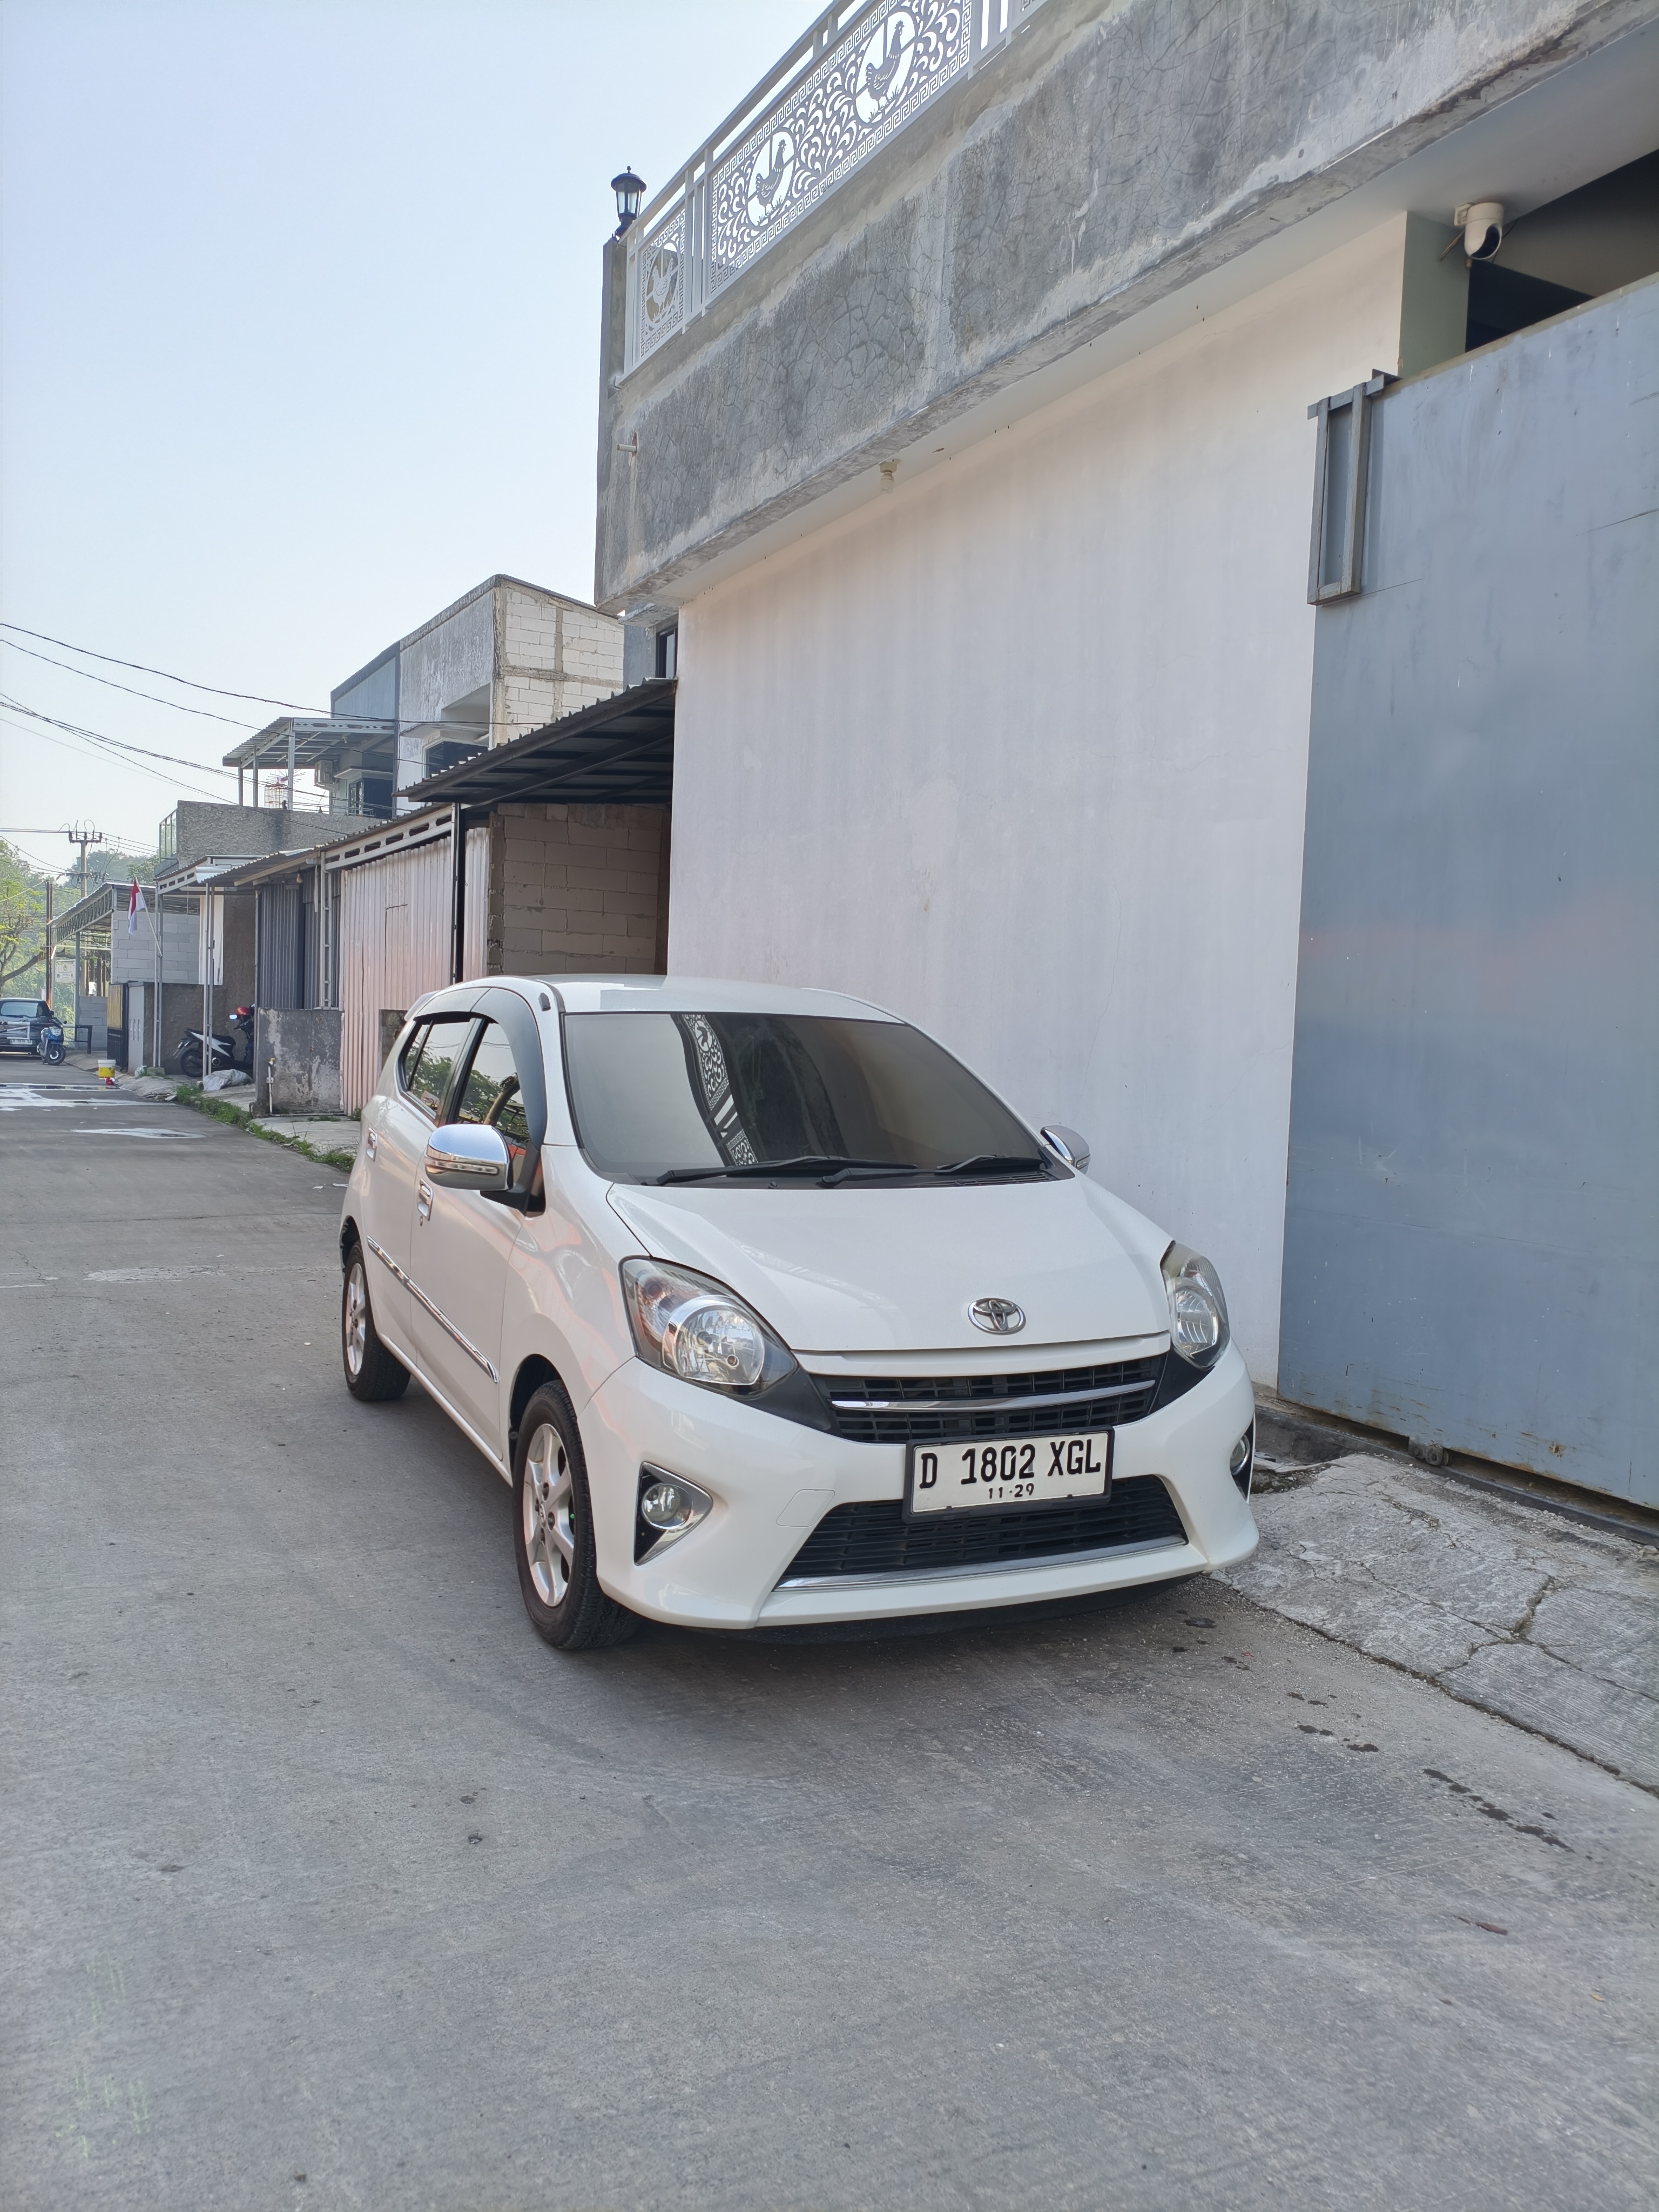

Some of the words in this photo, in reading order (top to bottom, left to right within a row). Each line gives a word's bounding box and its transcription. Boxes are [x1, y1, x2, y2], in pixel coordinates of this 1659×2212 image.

[919, 1452, 938, 1489] D
[961, 1444, 1035, 1485] 1802
[1047, 1439, 1101, 1476] XGL
